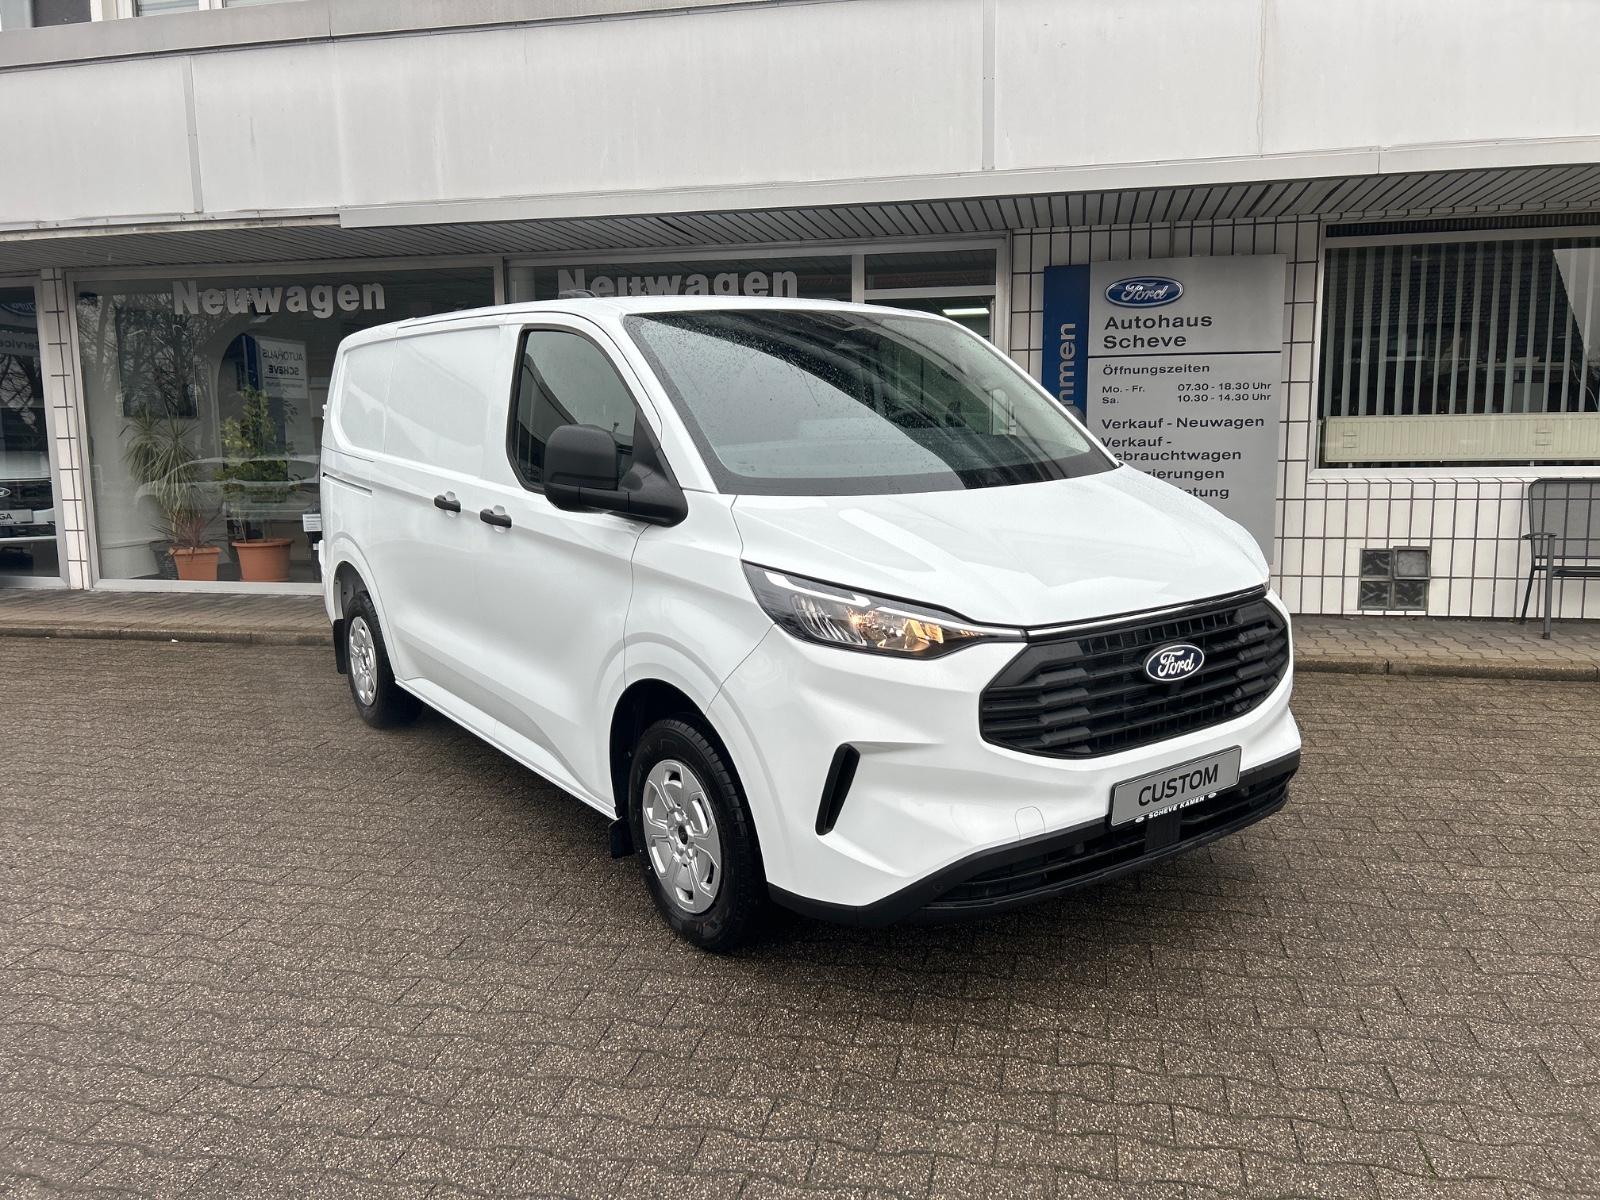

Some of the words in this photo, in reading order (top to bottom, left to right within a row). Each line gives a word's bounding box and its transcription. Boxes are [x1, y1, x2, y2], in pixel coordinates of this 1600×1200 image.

[1121, 282, 1169, 301] Ford
[172, 280, 386, 319] Neuwagen
[1104, 314, 1213, 330] Autohaus
[1103, 334, 1187, 349] Scheve
[1102, 364, 1210, 376] Öffnungszeiten
[1102, 385, 1123, 393] Mo.
[1132, 384, 1146, 393] Fr.
[1177, 383, 1209, 391] 07.30
[1219, 382, 1250, 390] 18.30
[1252, 382, 1272, 390] Uhr
[1102, 396, 1120, 404] Sa.
[1177, 394, 1209, 402] 10.30
[1219, 393, 1249, 401] 14.30
[1252, 393, 1272, 401] Uhr
[1102, 417, 1164, 429] Verkauf
[1176, 417, 1265, 430] Neuwagen
[1101, 436, 1164, 447] Verkauf
[1114, 450, 1242, 462] ebrauchtwagen
[1157, 650, 1195, 677] Ford
[1138, 764, 1219, 806] CUSTOM
[1148, 804, 1178, 819] SCHEVE
[1179, 795, 1205, 809] KAMEN
